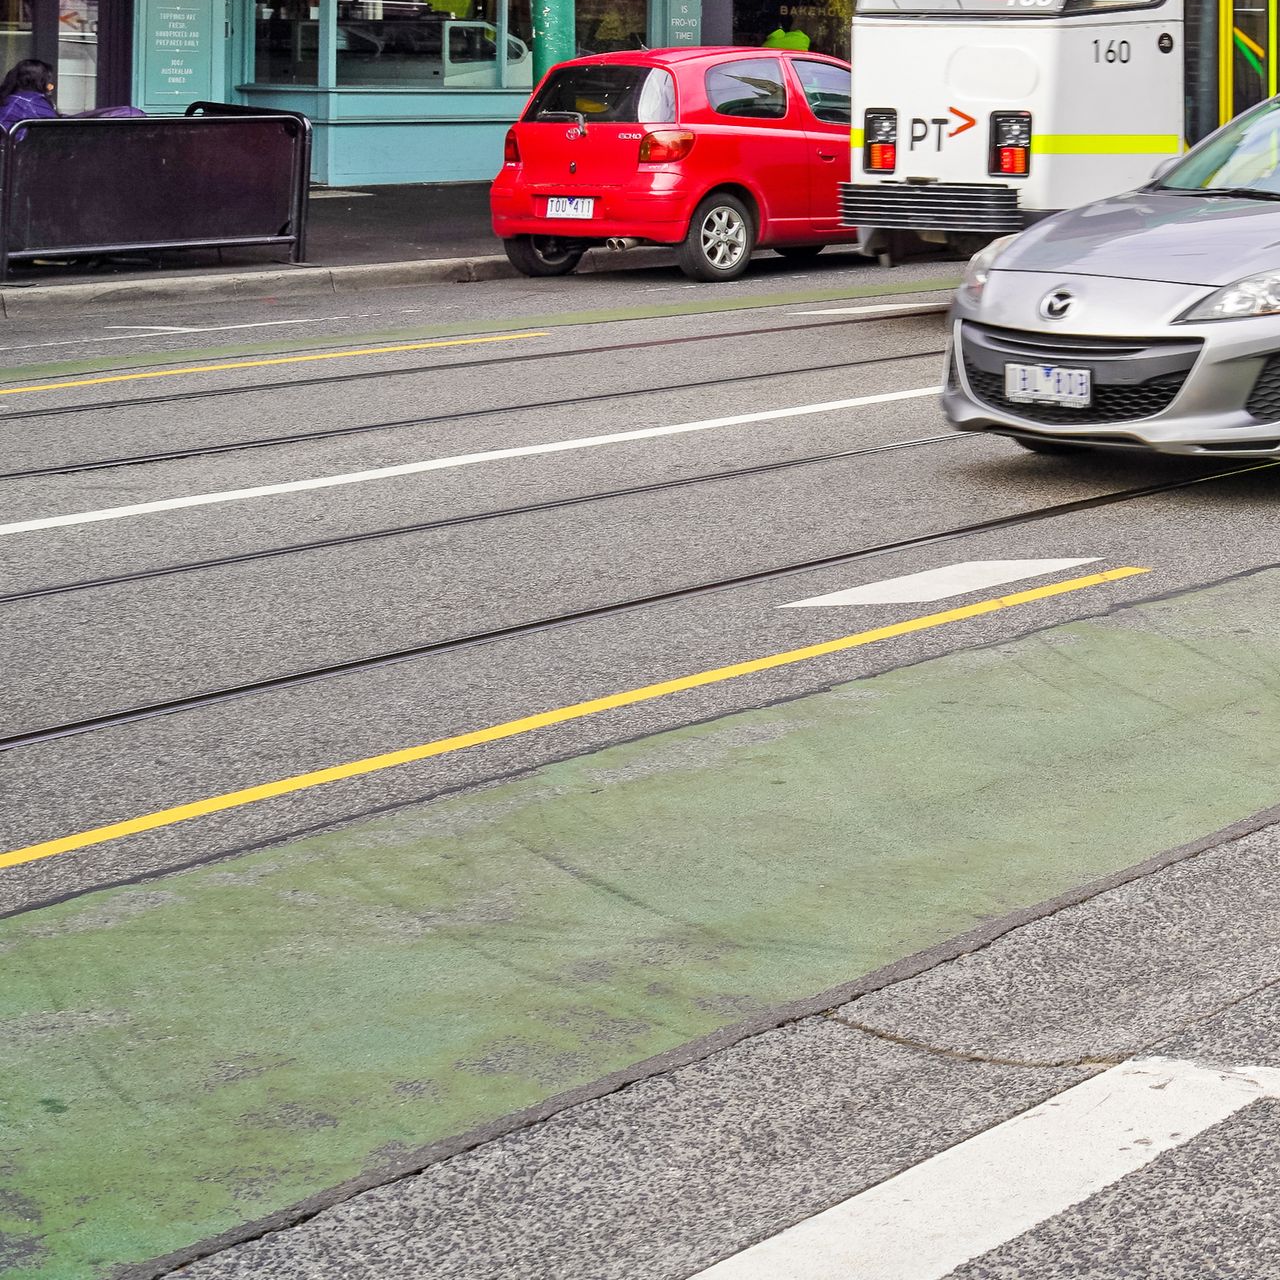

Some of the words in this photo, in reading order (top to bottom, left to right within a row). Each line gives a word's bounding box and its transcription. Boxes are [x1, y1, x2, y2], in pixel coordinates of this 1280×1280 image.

[780, 5, 840, 17] BAKEHO
[671, 18, 698, 26] FRO-YO
[675, 31, 694, 40] TIME!
[1093, 39, 1131, 63] 160
[909, 118, 949, 152] PT
[549, 199, 567, 212] TOU
[573, 200, 591, 213] 411
